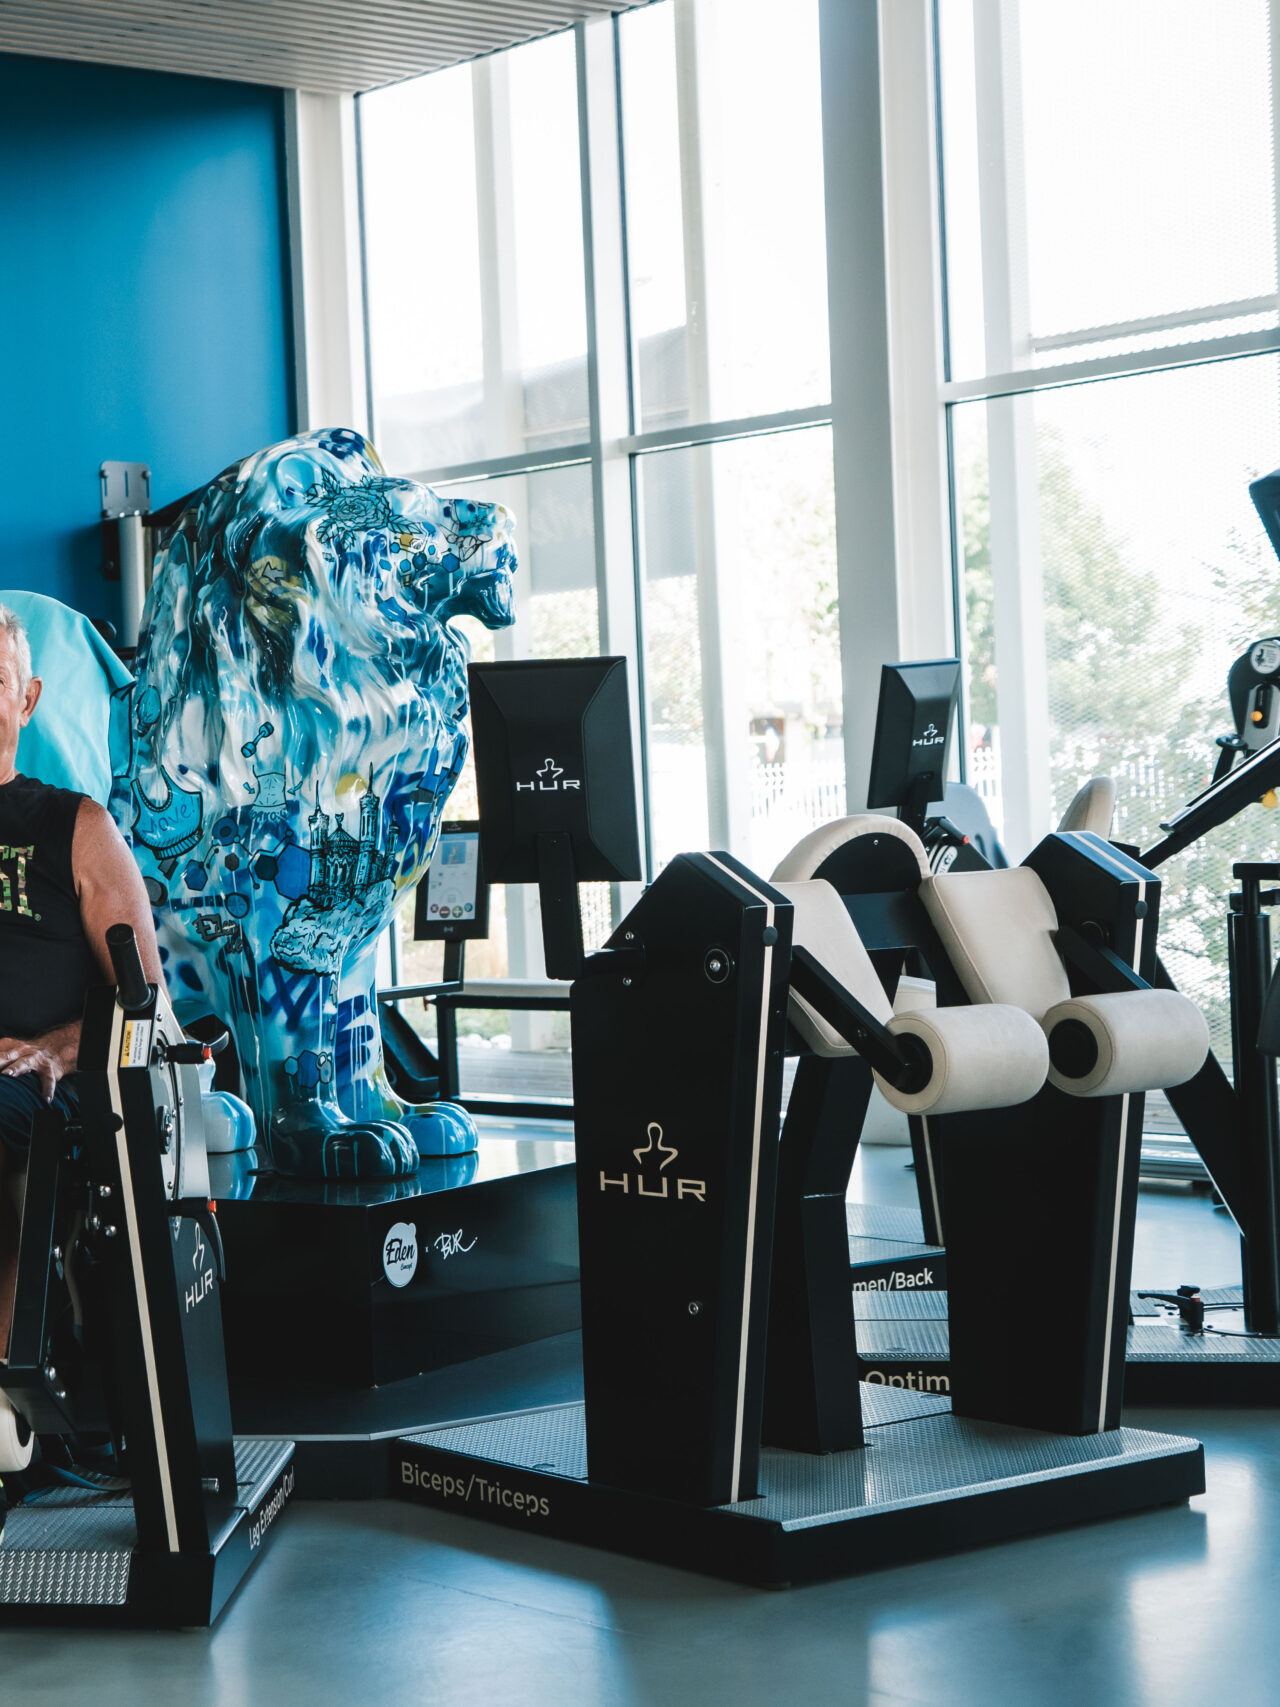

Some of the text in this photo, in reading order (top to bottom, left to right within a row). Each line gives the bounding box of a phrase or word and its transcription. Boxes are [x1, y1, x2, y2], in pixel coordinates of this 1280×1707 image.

[912, 736, 945, 747] HUR
[516, 779, 581, 792] HUR
[600, 1170, 706, 1202] HUR
[385, 1238, 415, 1265] Eden
[185, 1268, 213, 1314] HUR
[401, 1461, 550, 1517] Biceps/Triceps
[249, 1465, 295, 1551] Leg Extension/Curl
